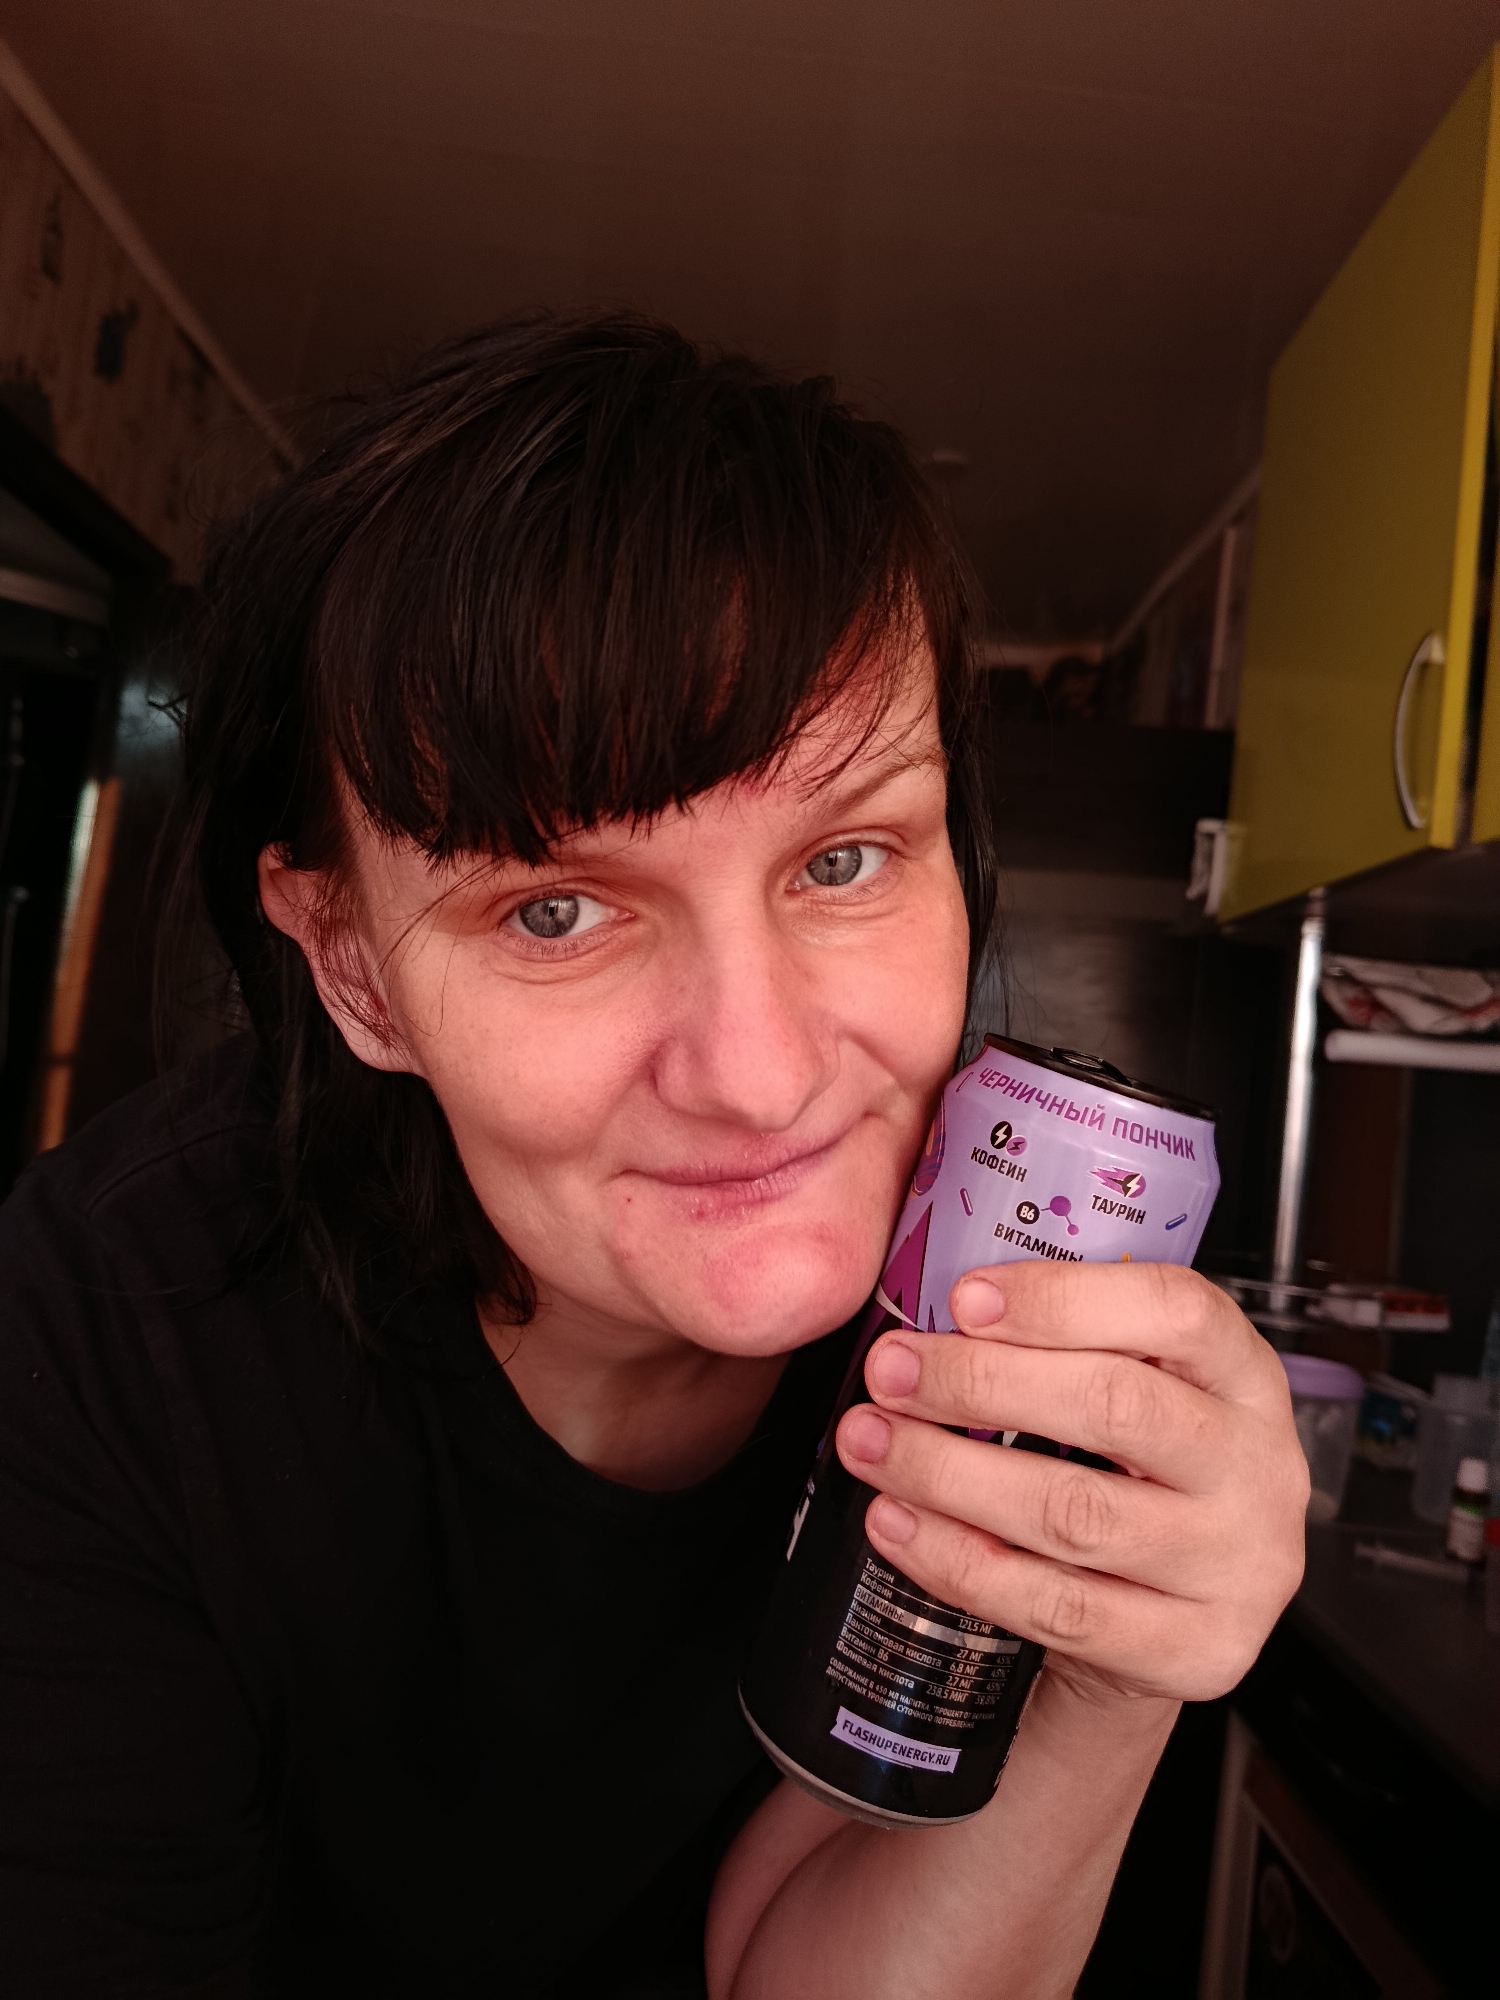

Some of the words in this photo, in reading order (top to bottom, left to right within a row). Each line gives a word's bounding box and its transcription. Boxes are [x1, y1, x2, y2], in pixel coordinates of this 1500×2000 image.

[978, 1067, 1106, 1131] ЧЕРНИЧНЫЙ
[1112, 1117, 1196, 1161] ПОНЧИК
[970, 1146, 1028, 1182] КОФЕИН
[1091, 1194, 1147, 1225] ТАУРИН
[994, 1222, 1084, 1262] ВИТАМИНЫ
[866, 1557, 895, 1584] Таурин
[850, 1599, 882, 1626] Ниацин
[956, 1648, 969, 1659] 27
[969, 1651, 984, 1662] МГ
[861, 1571, 893, 1599] Кофеин
[980, 1624, 995, 1635] МГ
[836, 1640, 878, 1673] Фолиевая
[879, 1668, 915, 1689] кислота
[949, 1691, 969, 1703] МКГ
[840, 1626, 877, 1656] Витамин
[945, 1675, 959, 1686] 2,7
[959, 1679, 974, 1690] МГ
[845, 1612, 905, 1653] Пантотеновая
[905, 1647, 942, 1667] кислота
[949, 1661, 964, 1673] 6,8
[964, 1664, 979, 1676] МГ
[825, 1666, 867, 1696] ДОПУСТИМЫХ
[867, 1690, 897, 1710] УРОВНЕЙ
[896, 1704, 933, 1722] СУТОЧНОГО
[829, 1657, 870, 1686] СОДЕРЖАНИЕ
[888, 1690, 900, 1701] МЛ
[842, 1719, 951, 1767] FLASHUPENERGY.RU
